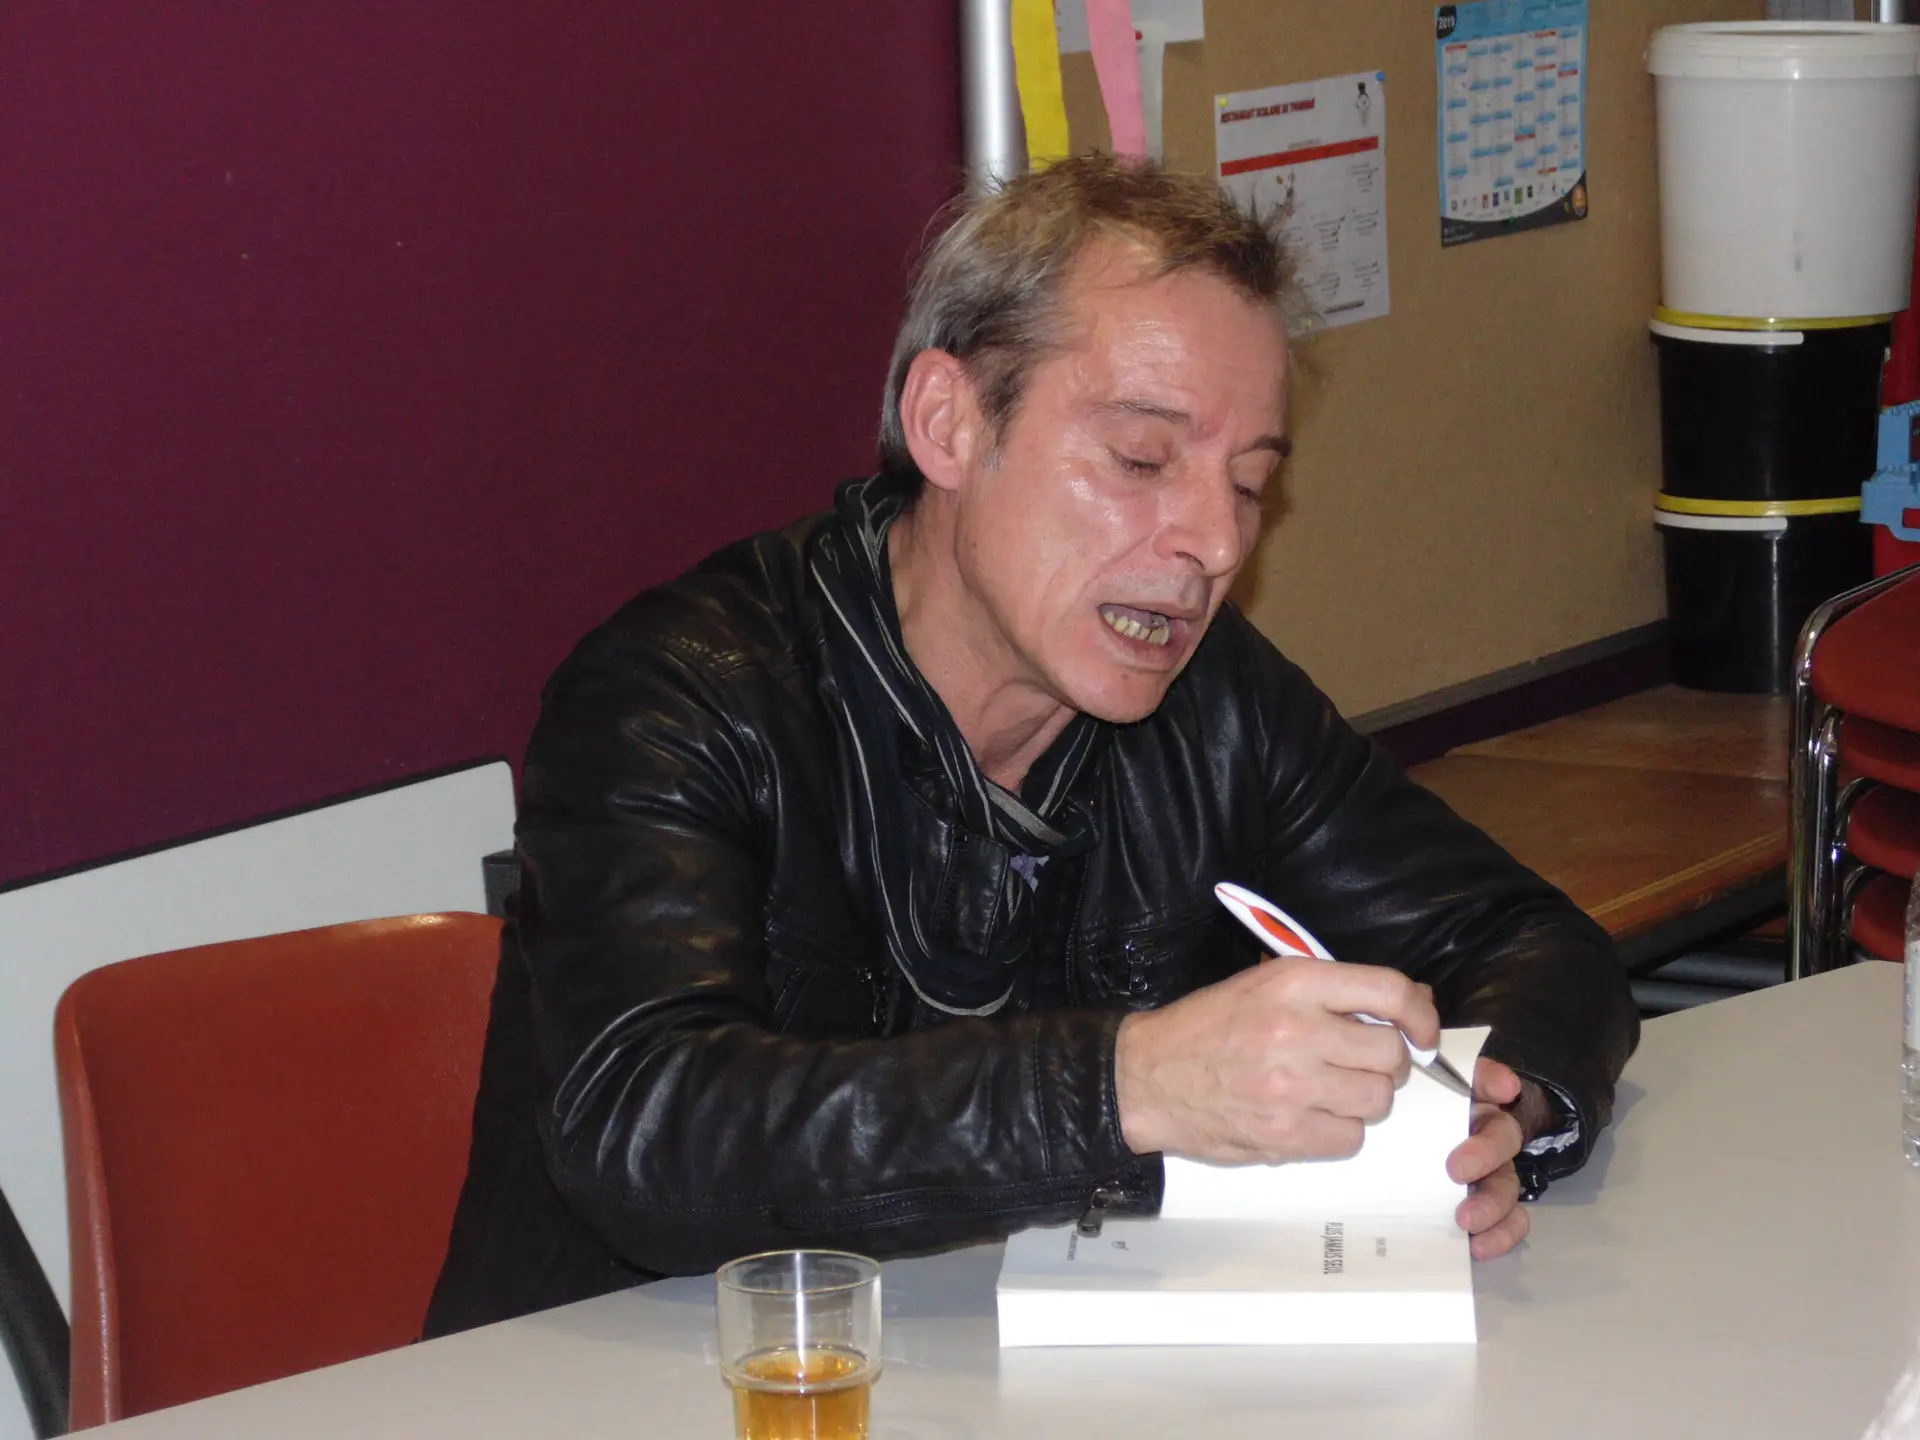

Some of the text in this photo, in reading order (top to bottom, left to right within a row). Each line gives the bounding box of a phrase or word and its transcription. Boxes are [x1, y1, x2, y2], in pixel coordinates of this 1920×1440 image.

[1439, 15, 1455, 29] 2019
[1319, 1235, 1344, 1258] JAMAIS
[1323, 1259, 1344, 1275] SEUL
